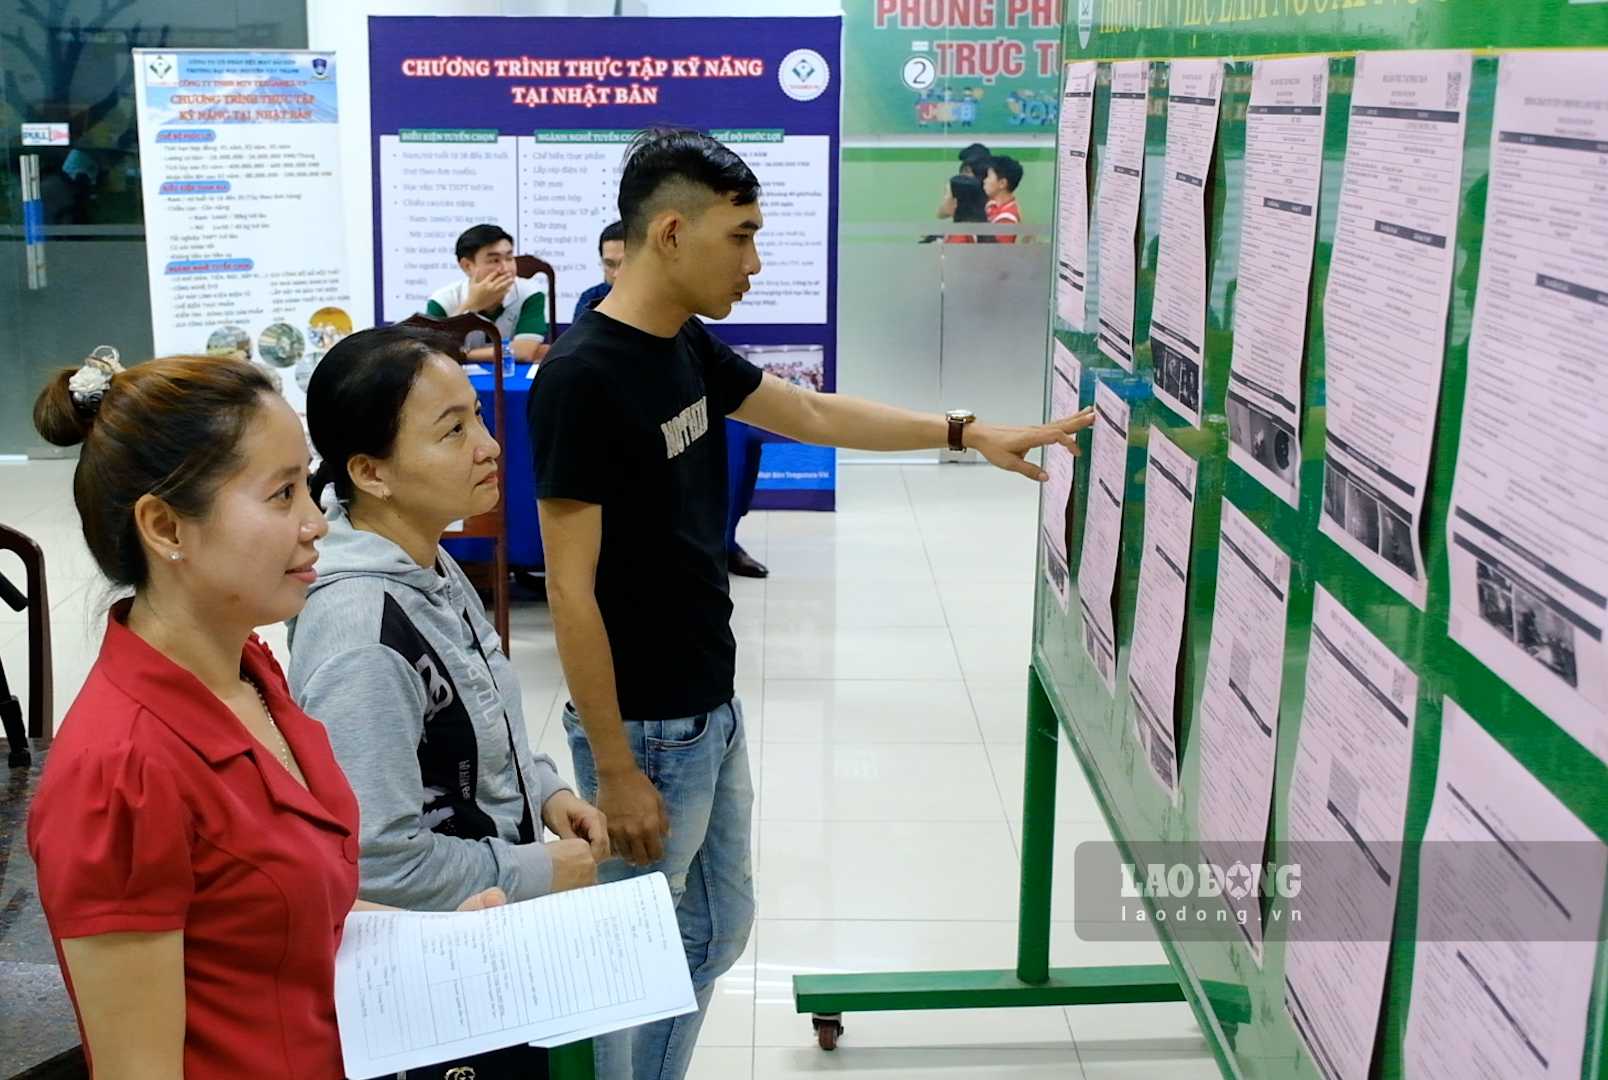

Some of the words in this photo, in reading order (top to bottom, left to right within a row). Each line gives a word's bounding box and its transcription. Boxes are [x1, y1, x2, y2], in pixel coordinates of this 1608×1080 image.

[402, 55, 491, 77] CHƯƠNG
[494, 56, 561, 77] TRÌNH
[564, 57, 623, 81] THỰC
[627, 57, 668, 81] TẬP
[672, 55, 700, 77] KỸ
[704, 56, 764, 77] NĂNG
[912, 60, 926, 84] 2
[935, 38, 1023, 83] TRỰC
[511, 86, 547, 108] TẠI
[552, 83, 610, 108] NHẬT
[615, 84, 658, 104] BẢN
